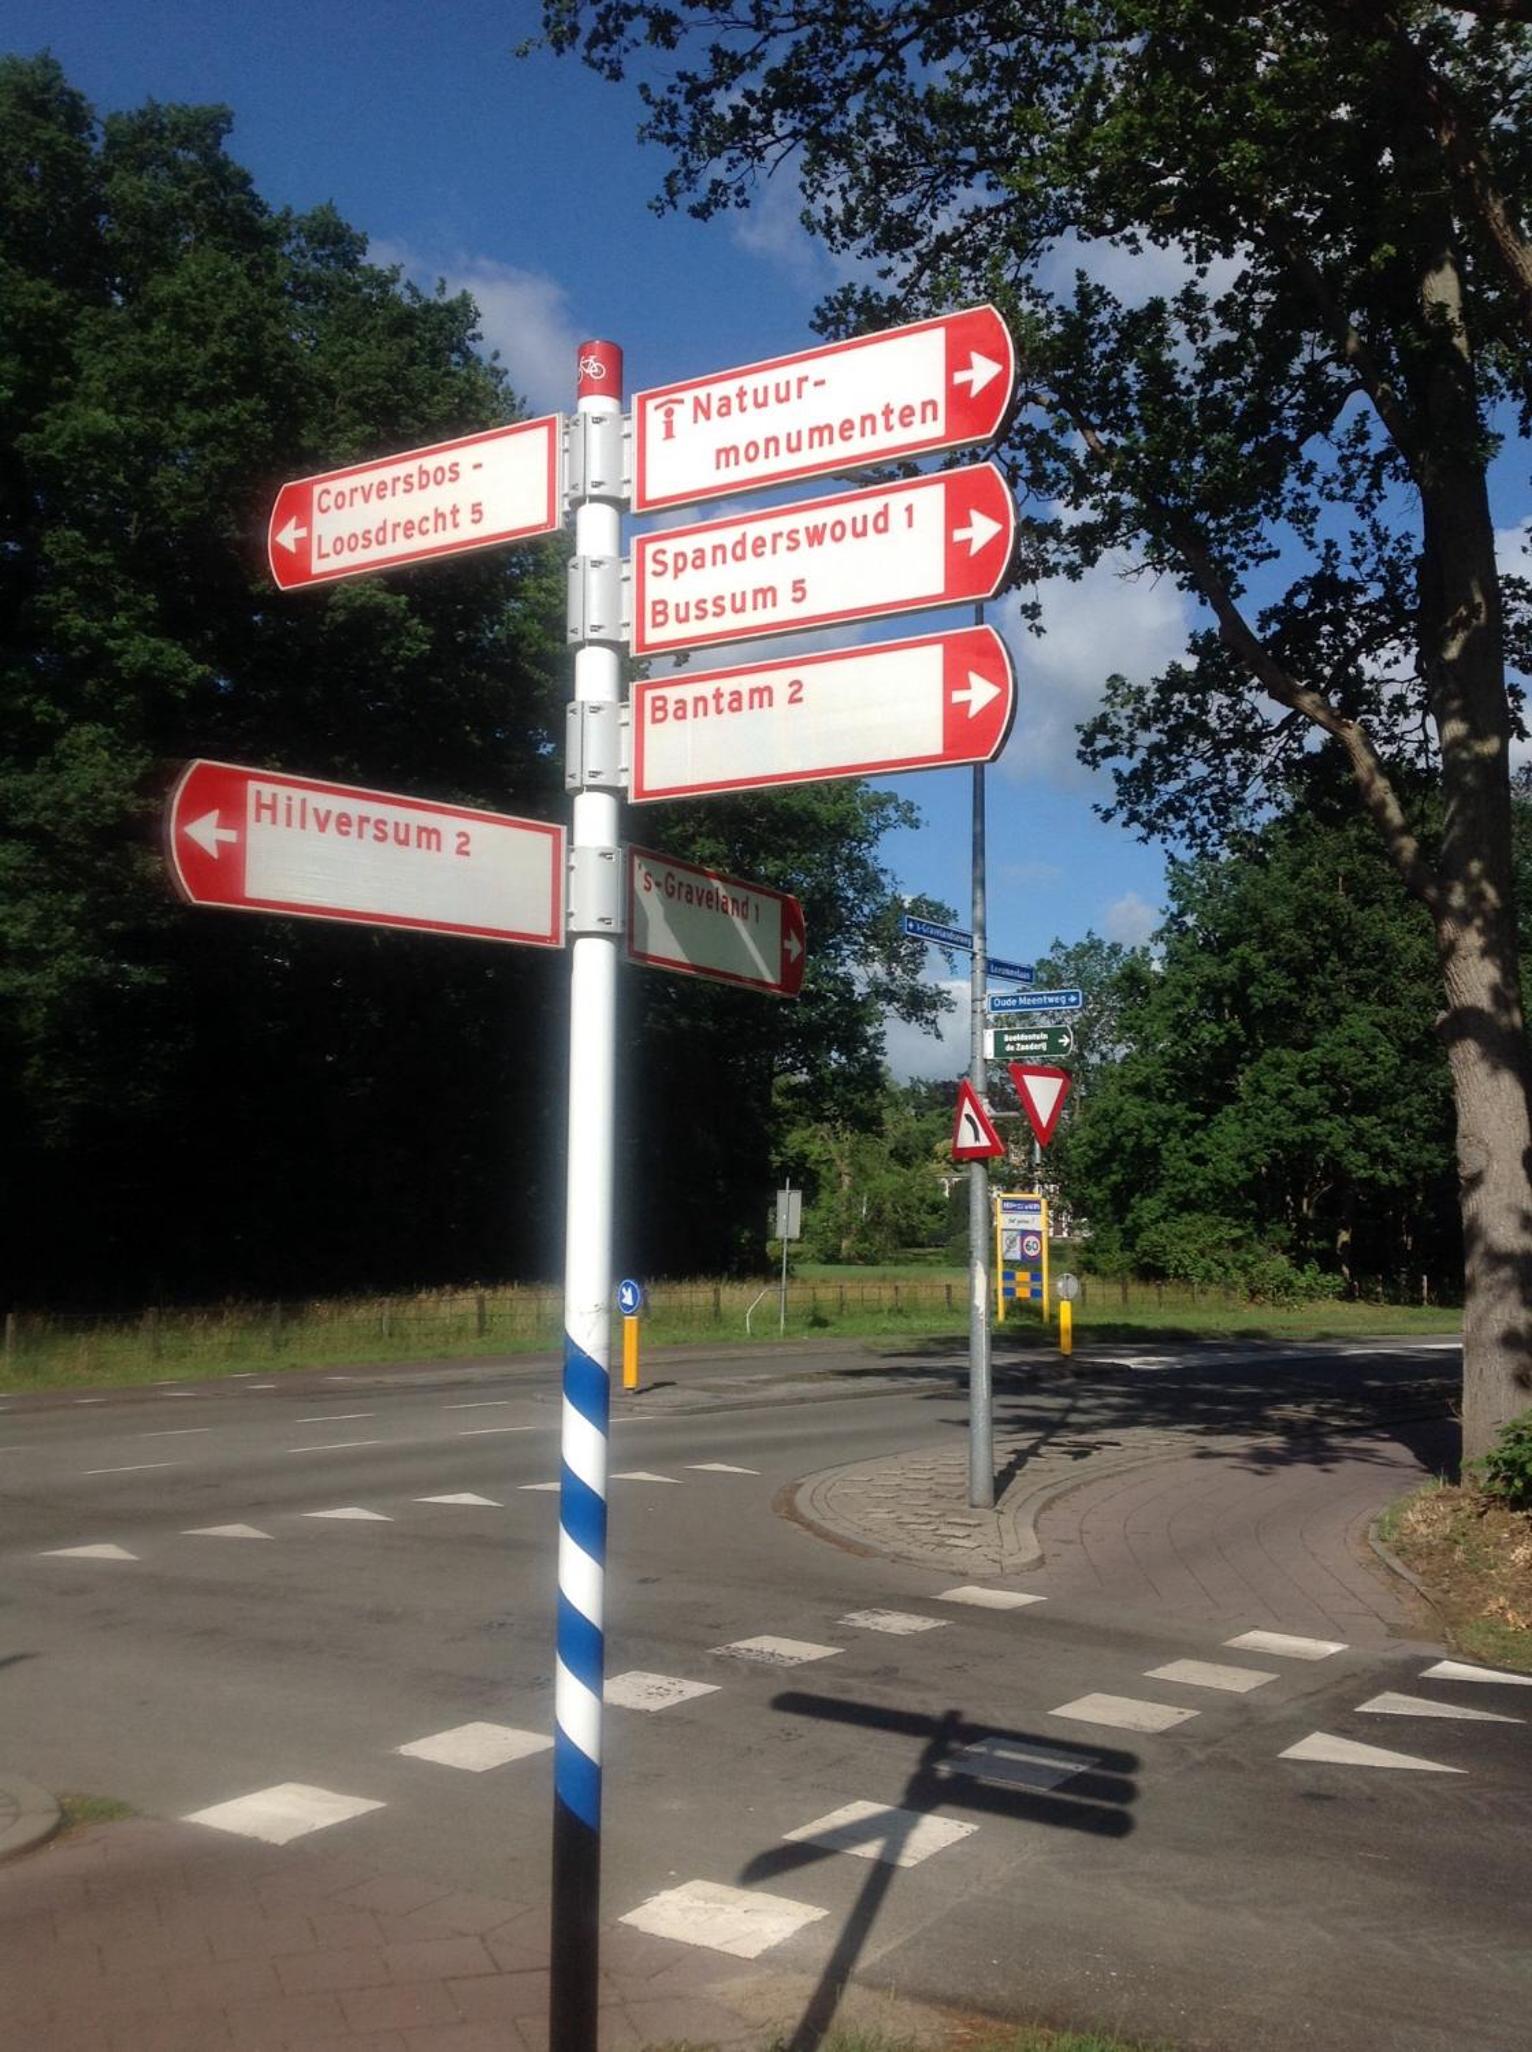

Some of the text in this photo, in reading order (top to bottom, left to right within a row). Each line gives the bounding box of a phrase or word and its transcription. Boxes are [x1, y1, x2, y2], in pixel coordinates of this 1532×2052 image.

[693, 376, 826, 424] Natuur-
[715, 398, 939, 470] monumenten
[317, 461, 460, 514] Corversbos
[316, 502, 484, 560] Loosdrecht 5
[651, 502, 914, 580] Spanderswoud 1
[651, 579, 807, 629] Bussum 5
[650, 679, 804, 724] Bantam 2
[254, 789, 471, 857] Hilversum 2
[754, 904, 760, 924] 1
[994, 995, 1067, 1007] Oude Meentweg
